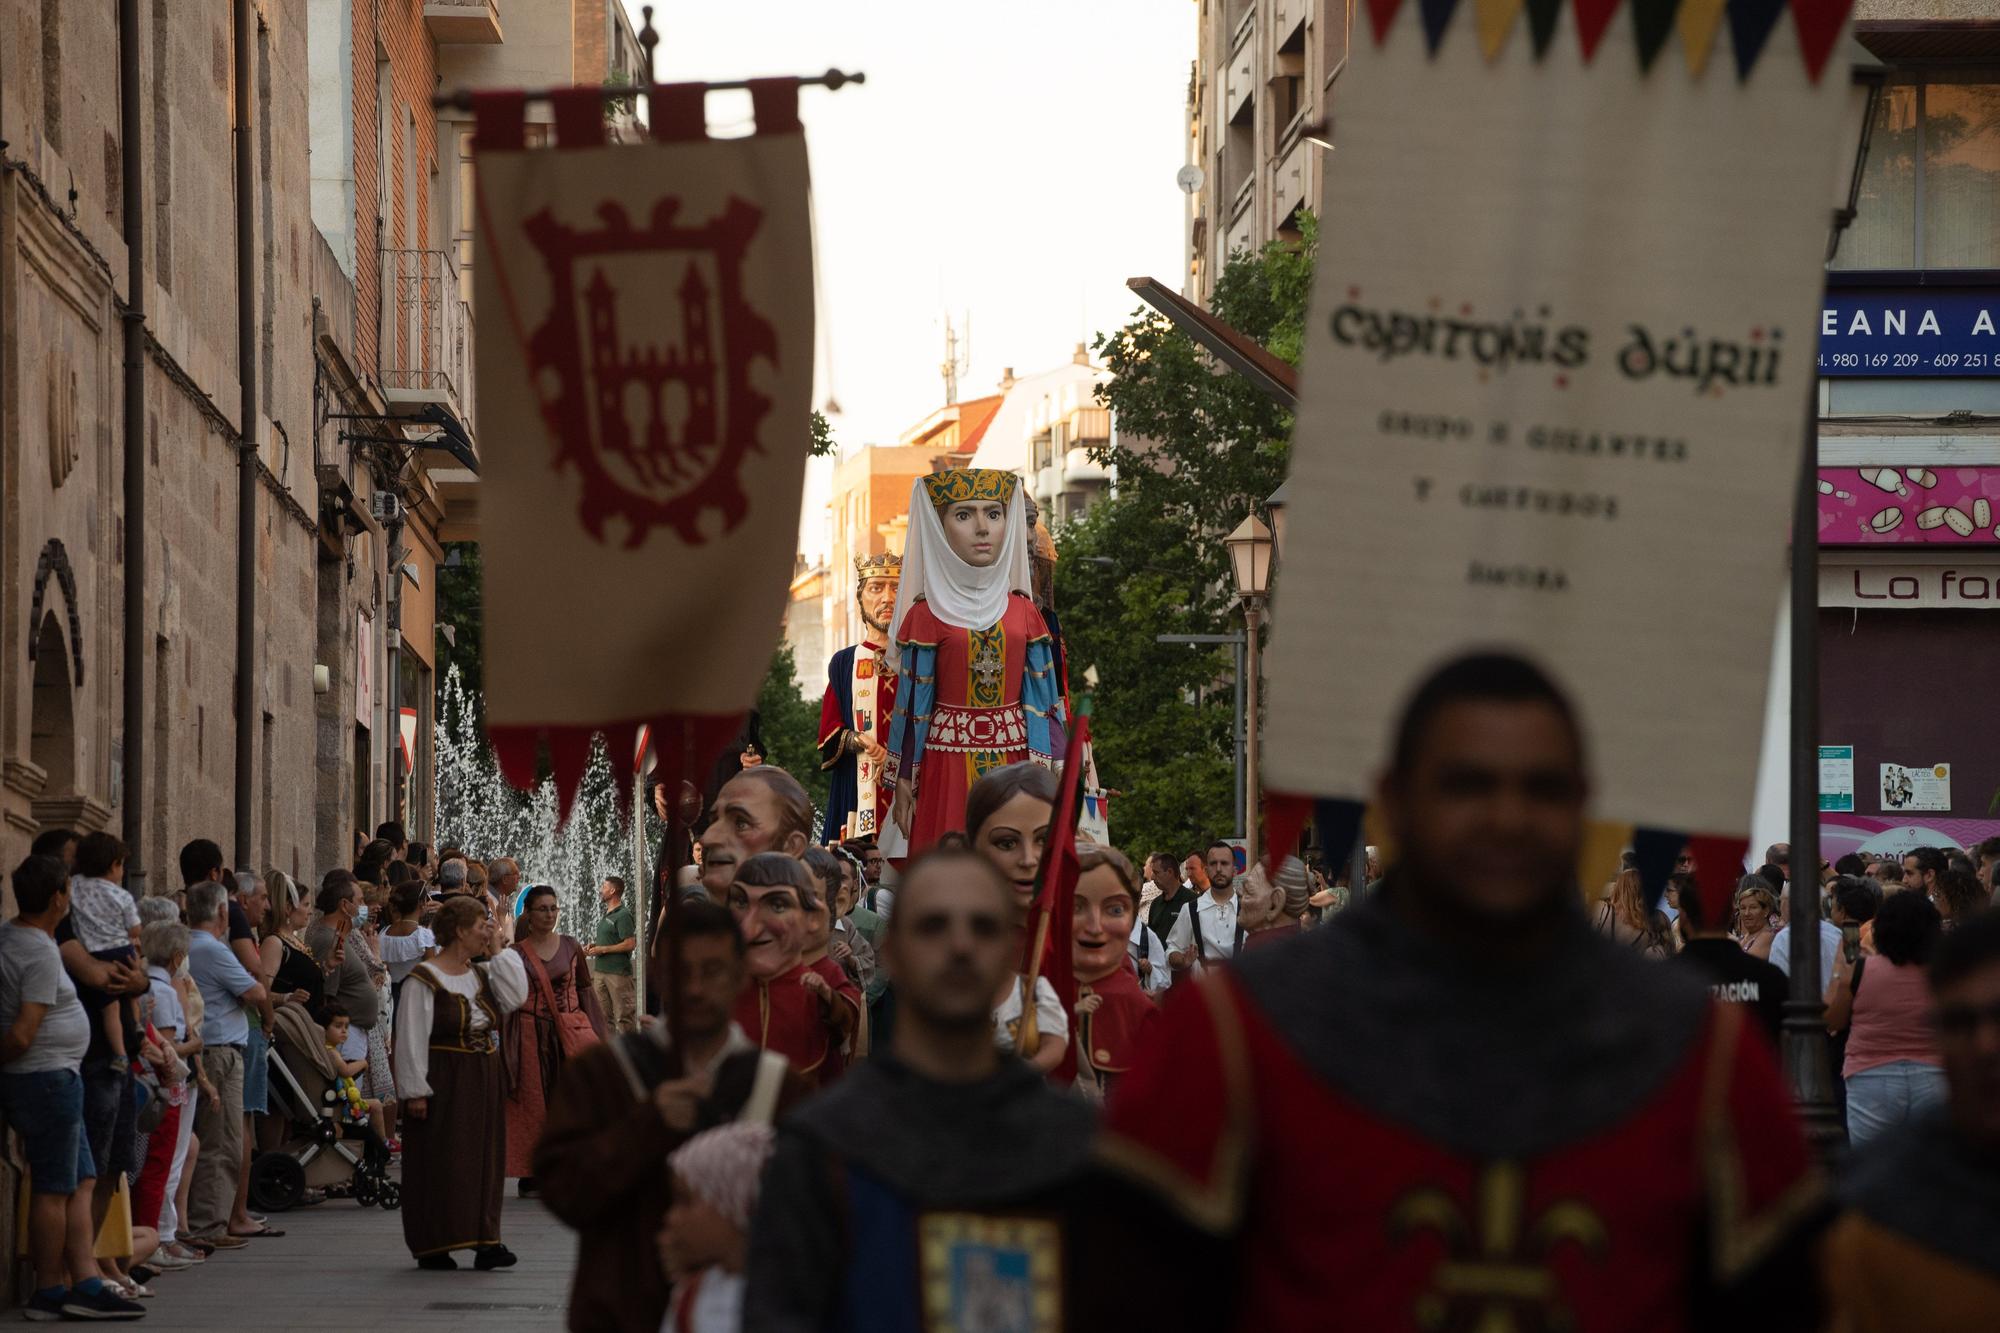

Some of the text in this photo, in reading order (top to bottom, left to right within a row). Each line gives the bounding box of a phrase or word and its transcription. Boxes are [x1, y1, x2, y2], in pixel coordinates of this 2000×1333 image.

[1832, 353, 1859, 367] 980
[1864, 353, 1888, 367] 169
[1893, 353, 1919, 367] 209
[1933, 353, 1959, 367] 609
[1963, 353, 1988, 367] 251
[1854, 569, 2000, 600] La fa
